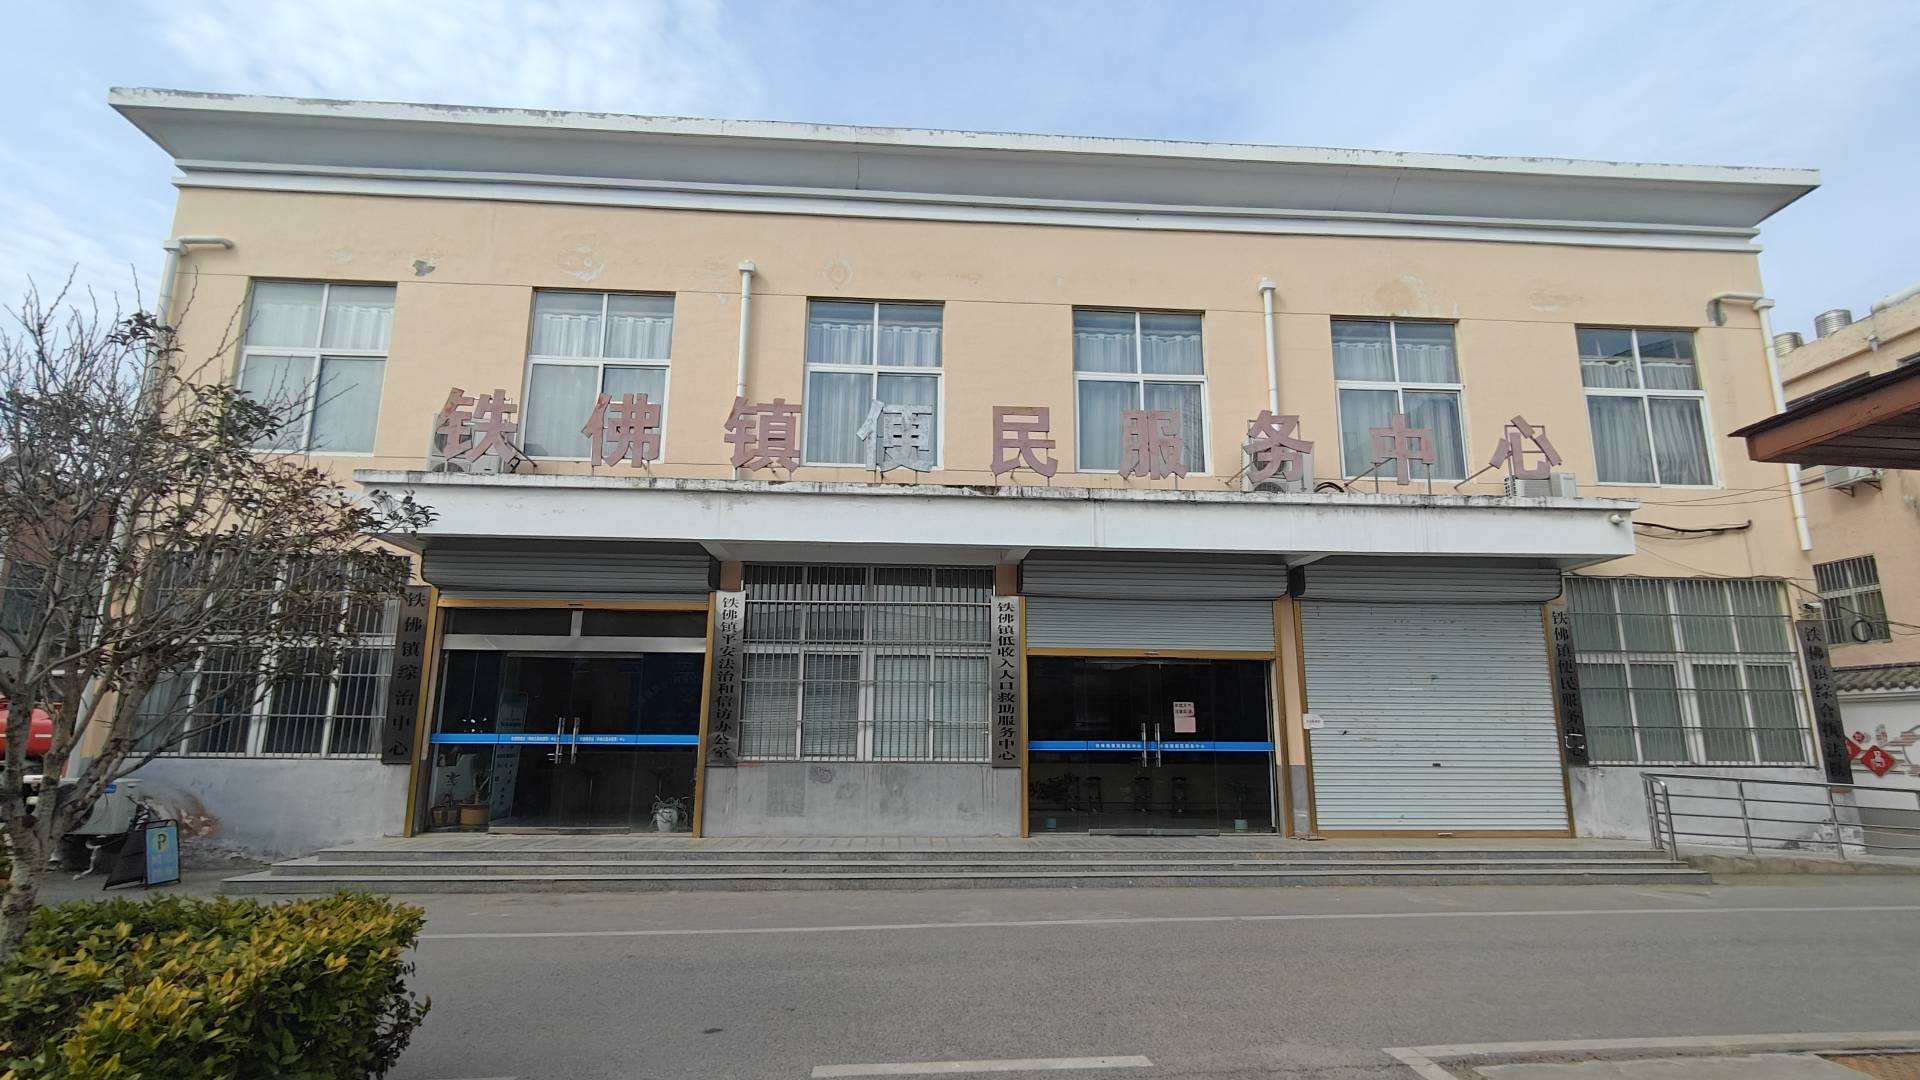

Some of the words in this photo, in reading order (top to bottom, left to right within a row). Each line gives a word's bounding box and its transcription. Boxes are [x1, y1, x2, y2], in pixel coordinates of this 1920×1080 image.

[436, 387, 1562, 485] 铁佛镇便民服务中心
[388, 592, 426, 756] 铁佛镇综治中心
[712, 597, 739, 758] 铁佛镇平安法治和信访办公室
[997, 602, 1016, 761] 铁佛镇低收入人口救助服务中心
